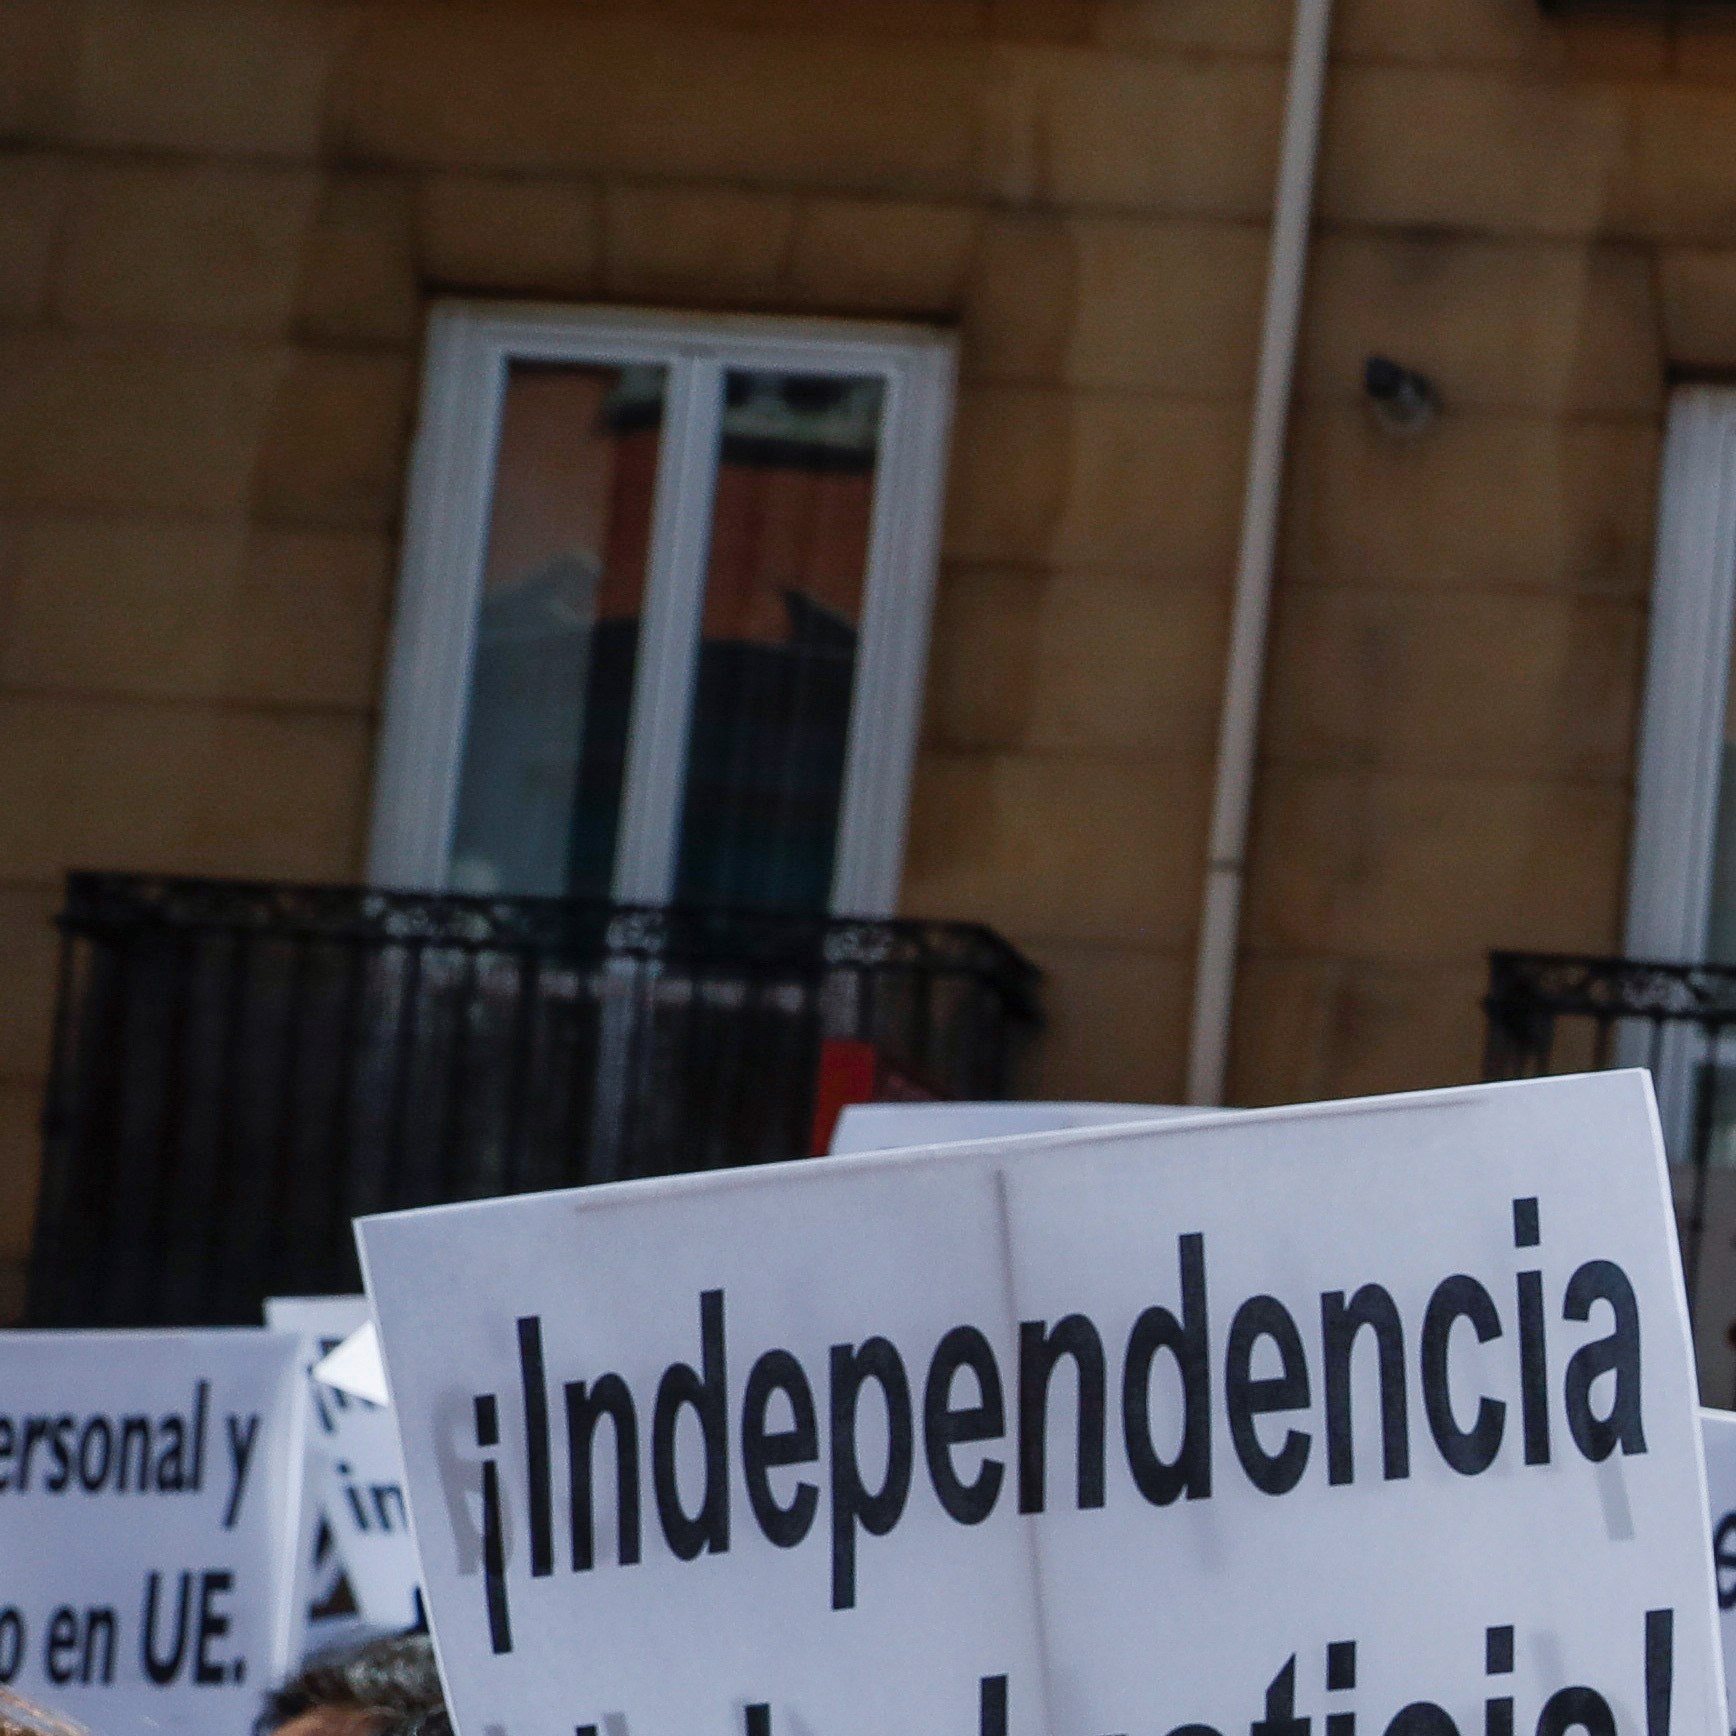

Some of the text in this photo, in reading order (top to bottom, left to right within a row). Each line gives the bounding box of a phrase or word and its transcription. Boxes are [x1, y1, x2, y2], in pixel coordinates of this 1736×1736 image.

[223, 1412, 260, 1530] y
[474, 1198, 1646, 1654] ¡Independencia
[43, 1604, 119, 1687] en
[140, 1570, 247, 1689] UE.
